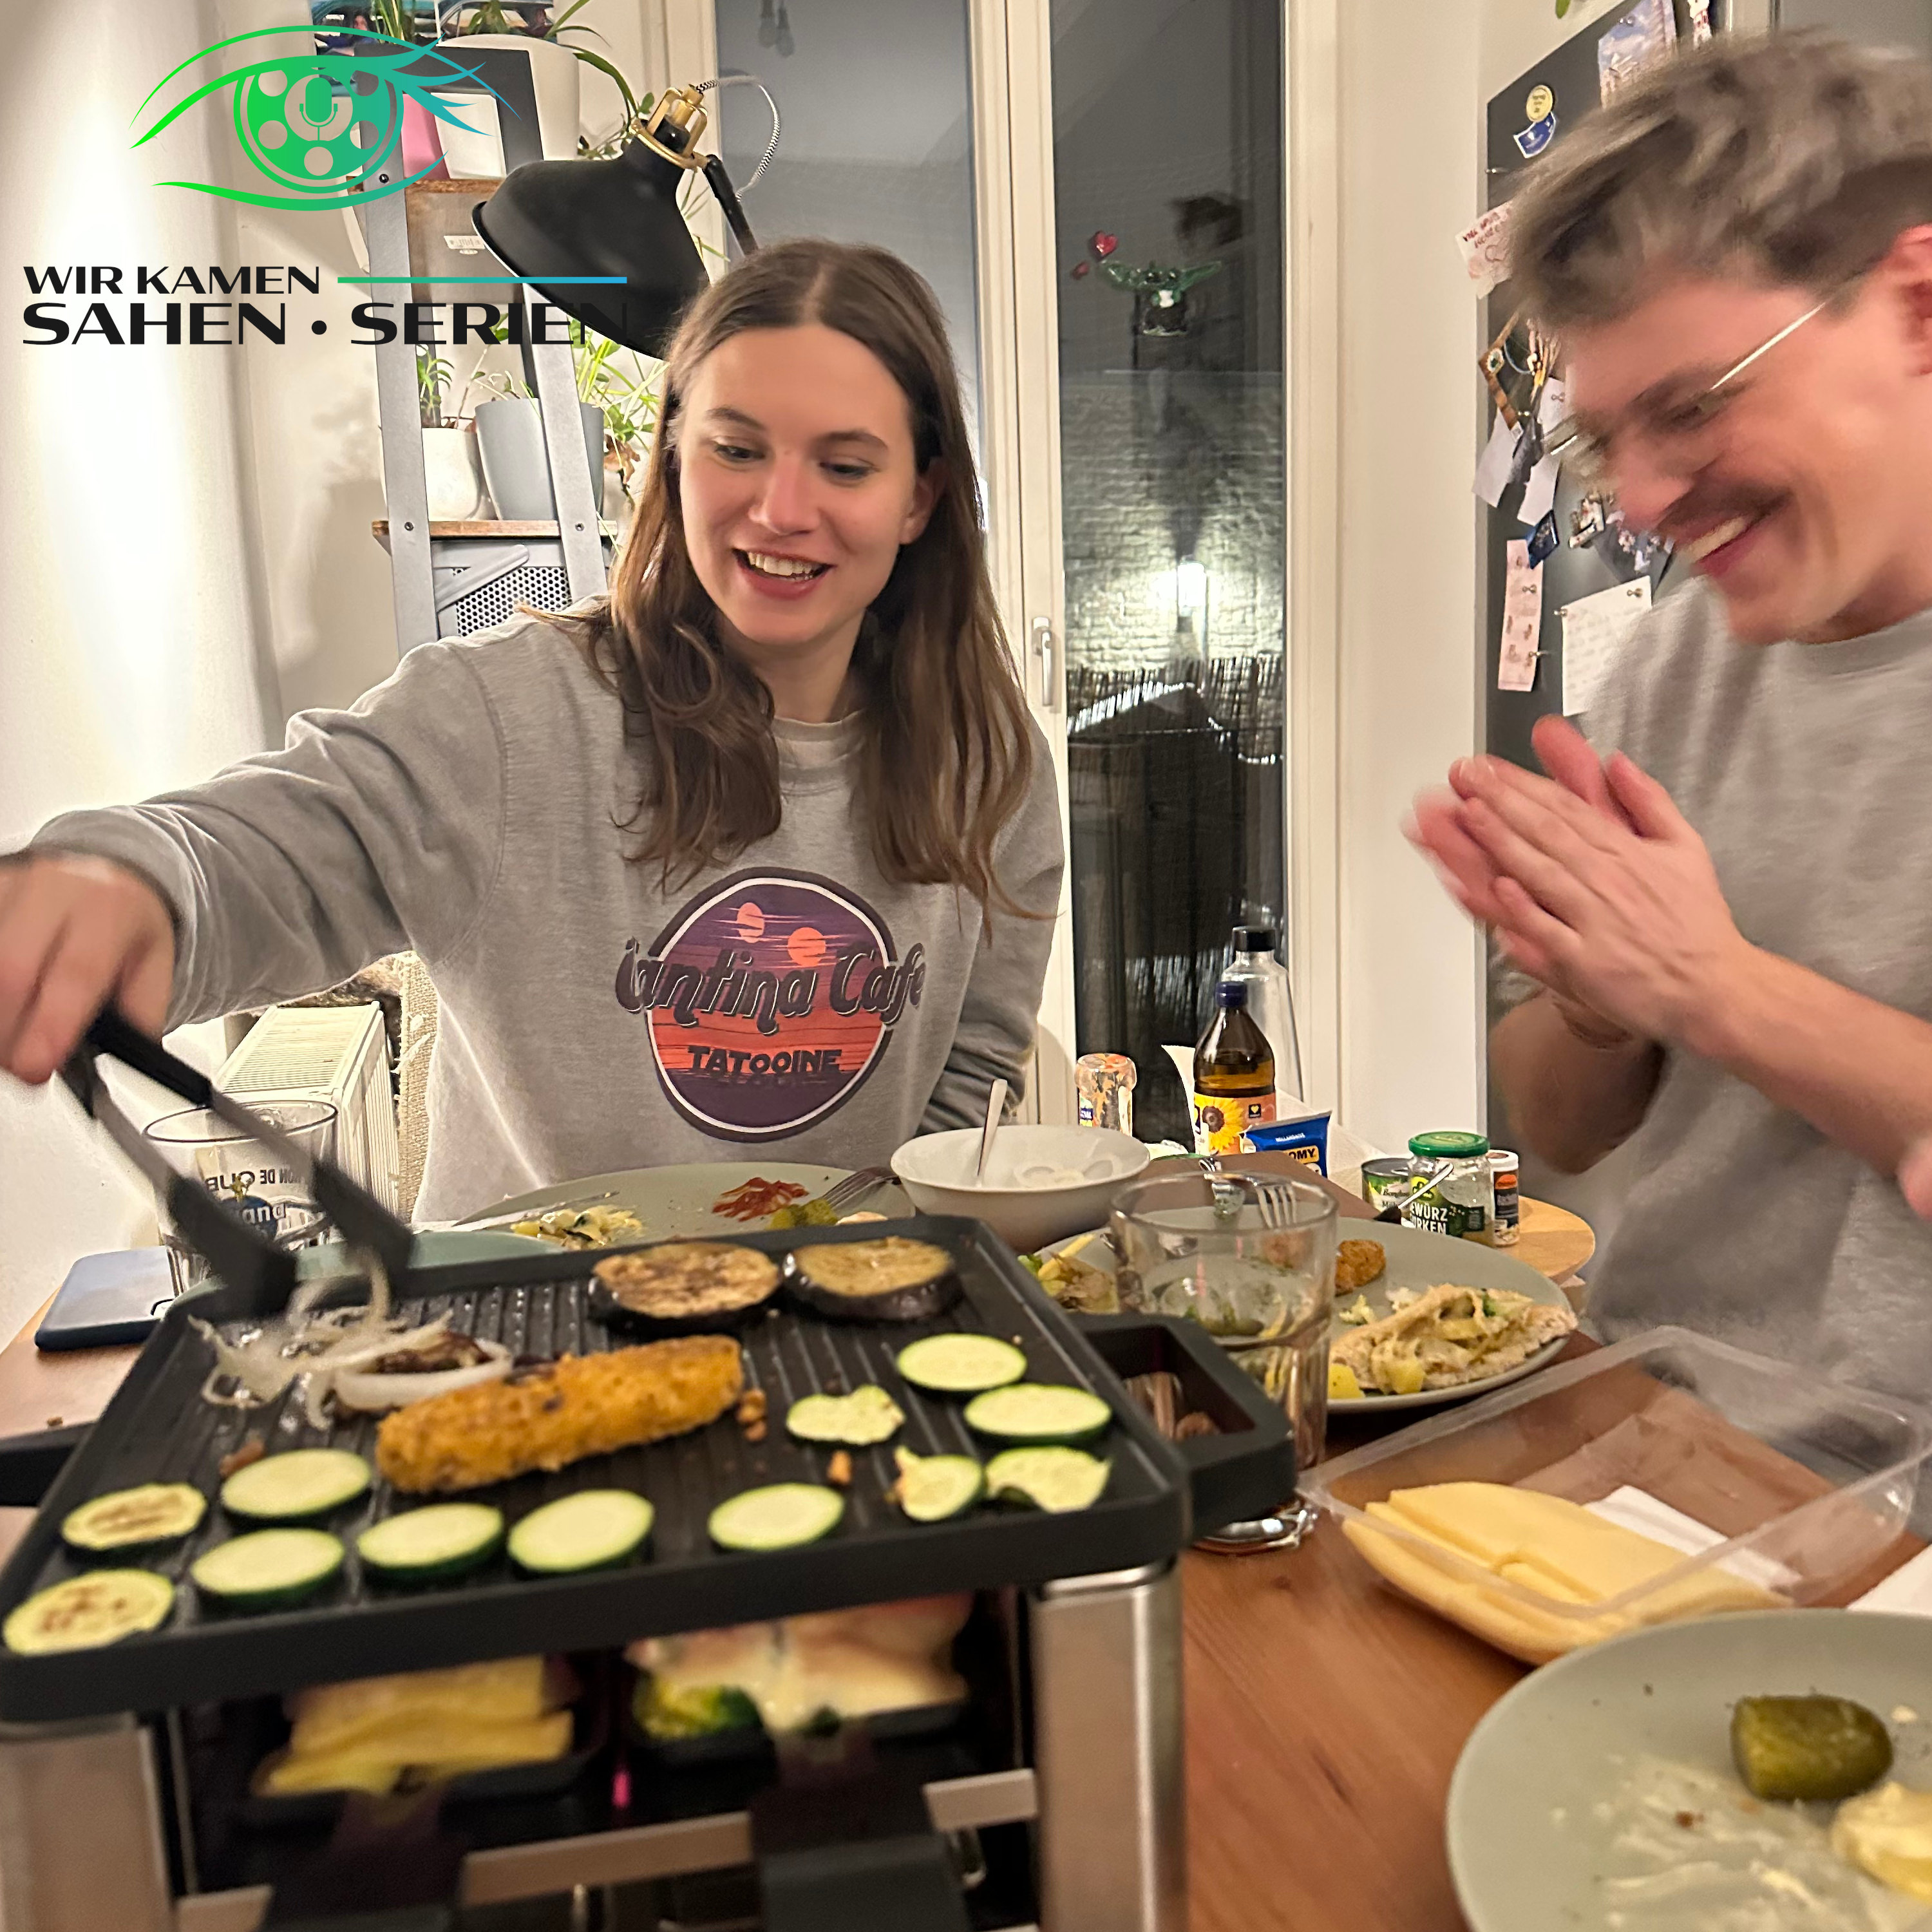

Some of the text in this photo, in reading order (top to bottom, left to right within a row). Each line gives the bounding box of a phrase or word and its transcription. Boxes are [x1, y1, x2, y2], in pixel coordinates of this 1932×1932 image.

[688, 1045, 842, 1074] TATOOINE
[1289, 1148, 1315, 1160] OMY
[1410, 1202, 1448, 1222] EWÜRZ
